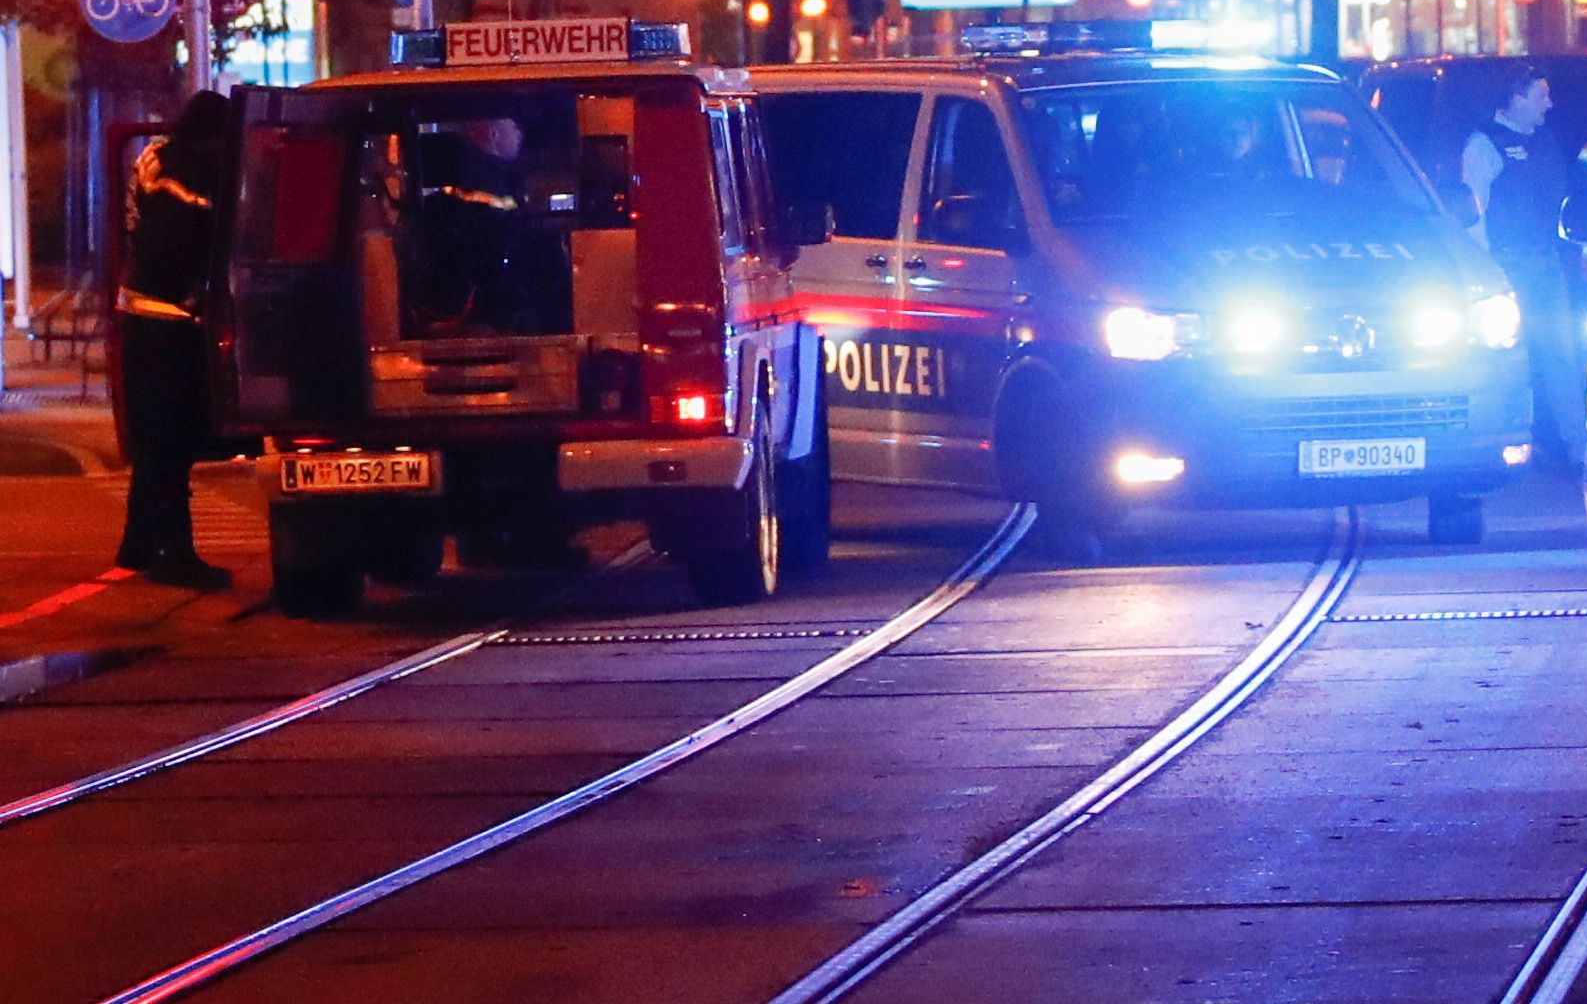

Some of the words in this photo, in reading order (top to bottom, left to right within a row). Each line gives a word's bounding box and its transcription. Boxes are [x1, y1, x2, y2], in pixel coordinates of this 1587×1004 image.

[449, 24, 625, 58] FEUERWEHR
[1211, 243, 1415, 265] POLIZEI
[1318, 448, 1343, 468] BP
[1356, 445, 1417, 466] 90340
